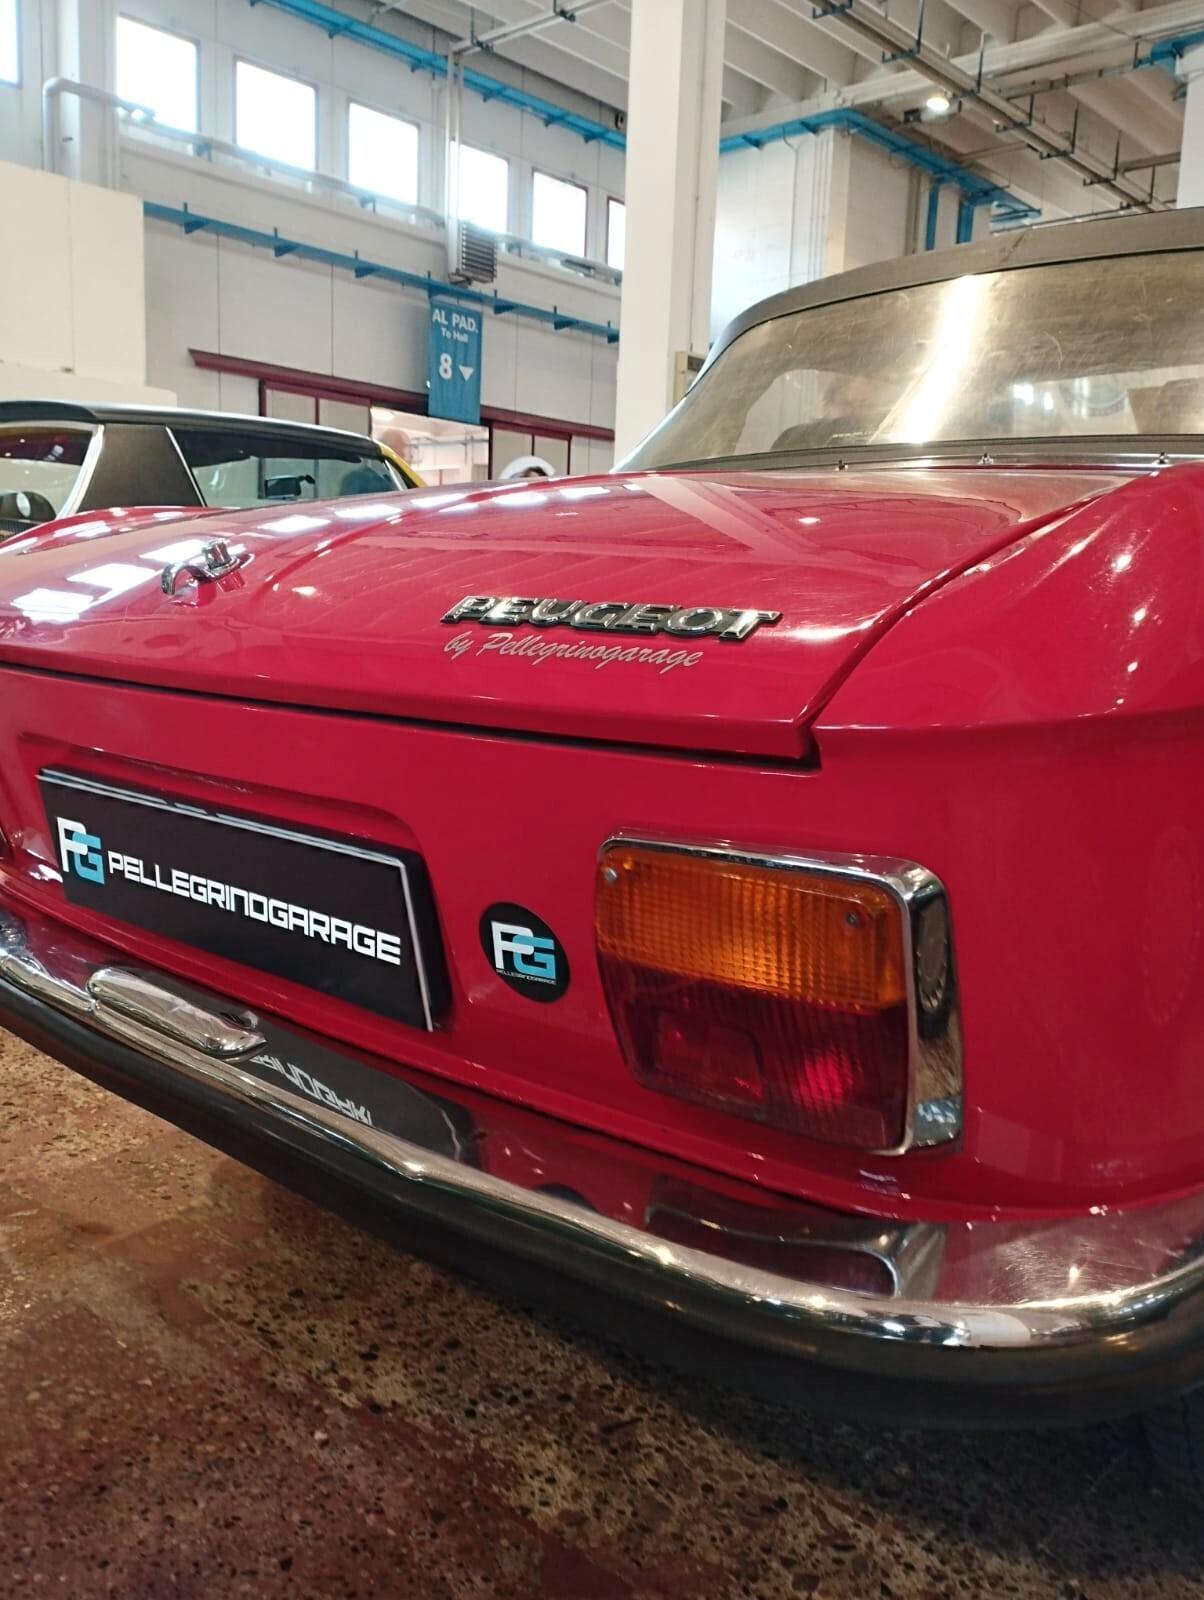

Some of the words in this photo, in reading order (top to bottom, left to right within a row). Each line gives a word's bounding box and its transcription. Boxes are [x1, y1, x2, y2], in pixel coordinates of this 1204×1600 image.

[432, 308, 448, 325] AL
[452, 313, 479, 333] PAD.
[441, 327, 451, 338] To
[453, 331, 469, 343] Hall
[439, 352, 452, 380] 8
[440, 595, 784, 642] PEUGEOT
[443, 631, 474, 660] by
[479, 632, 703, 674] Pellegrinogarage
[107, 850, 401, 966] PELLEGRINOGARAGE
